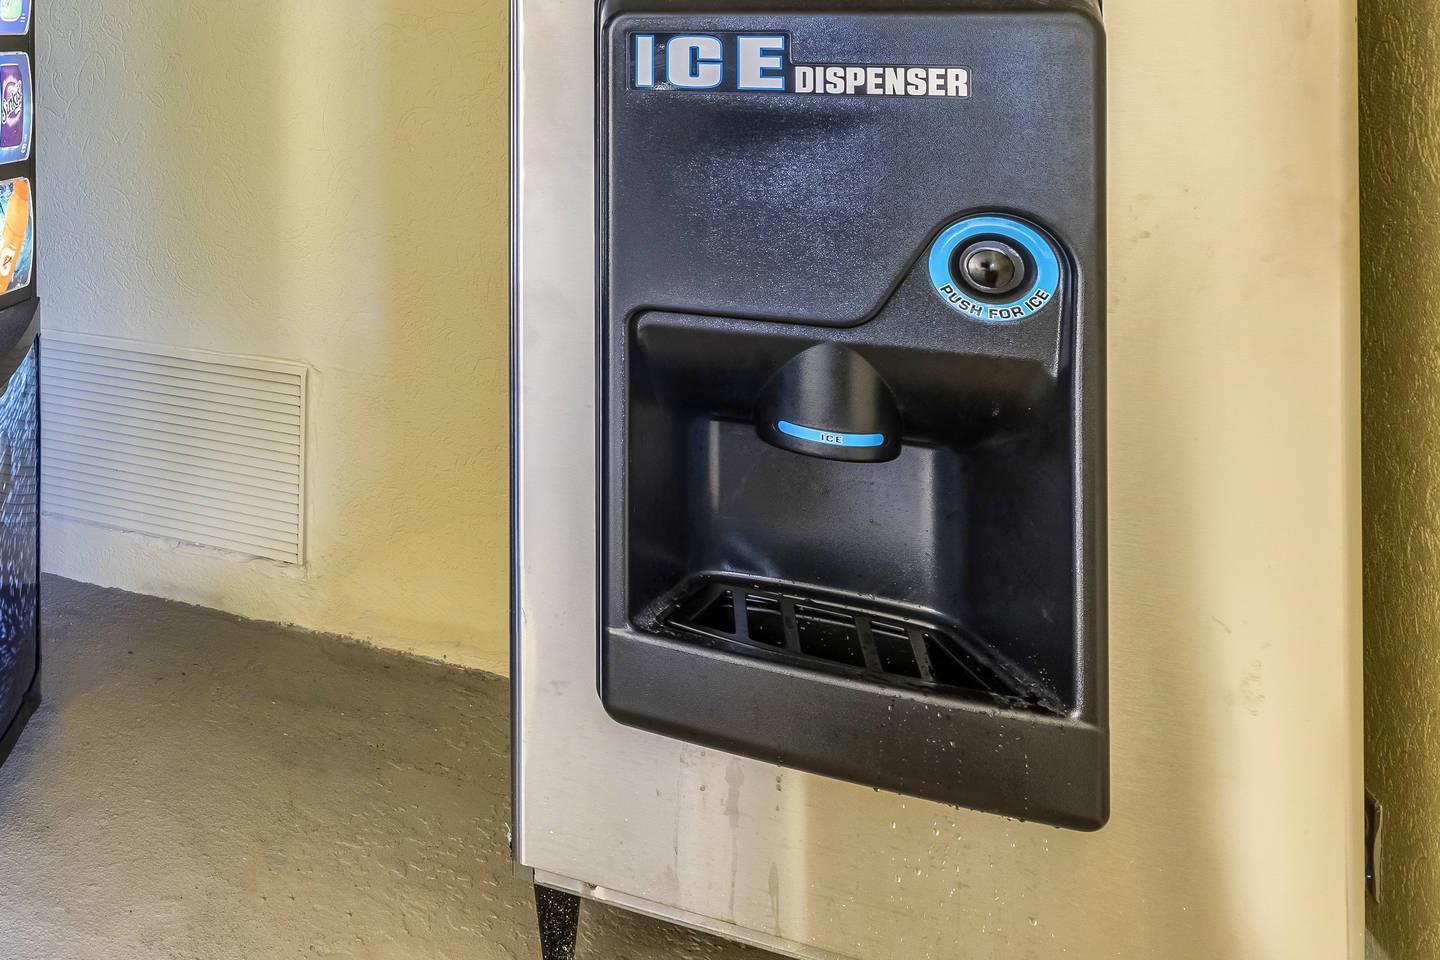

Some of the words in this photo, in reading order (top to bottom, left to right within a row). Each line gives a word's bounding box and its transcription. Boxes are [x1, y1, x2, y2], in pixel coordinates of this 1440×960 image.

[635, 34, 786, 90] ICE
[794, 66, 969, 97] DISPENSER
[939, 284, 983, 317] PUSH
[989, 306, 1024, 320] FOR
[1025, 289, 1049, 311] ICE
[820, 433, 843, 444] ICE
